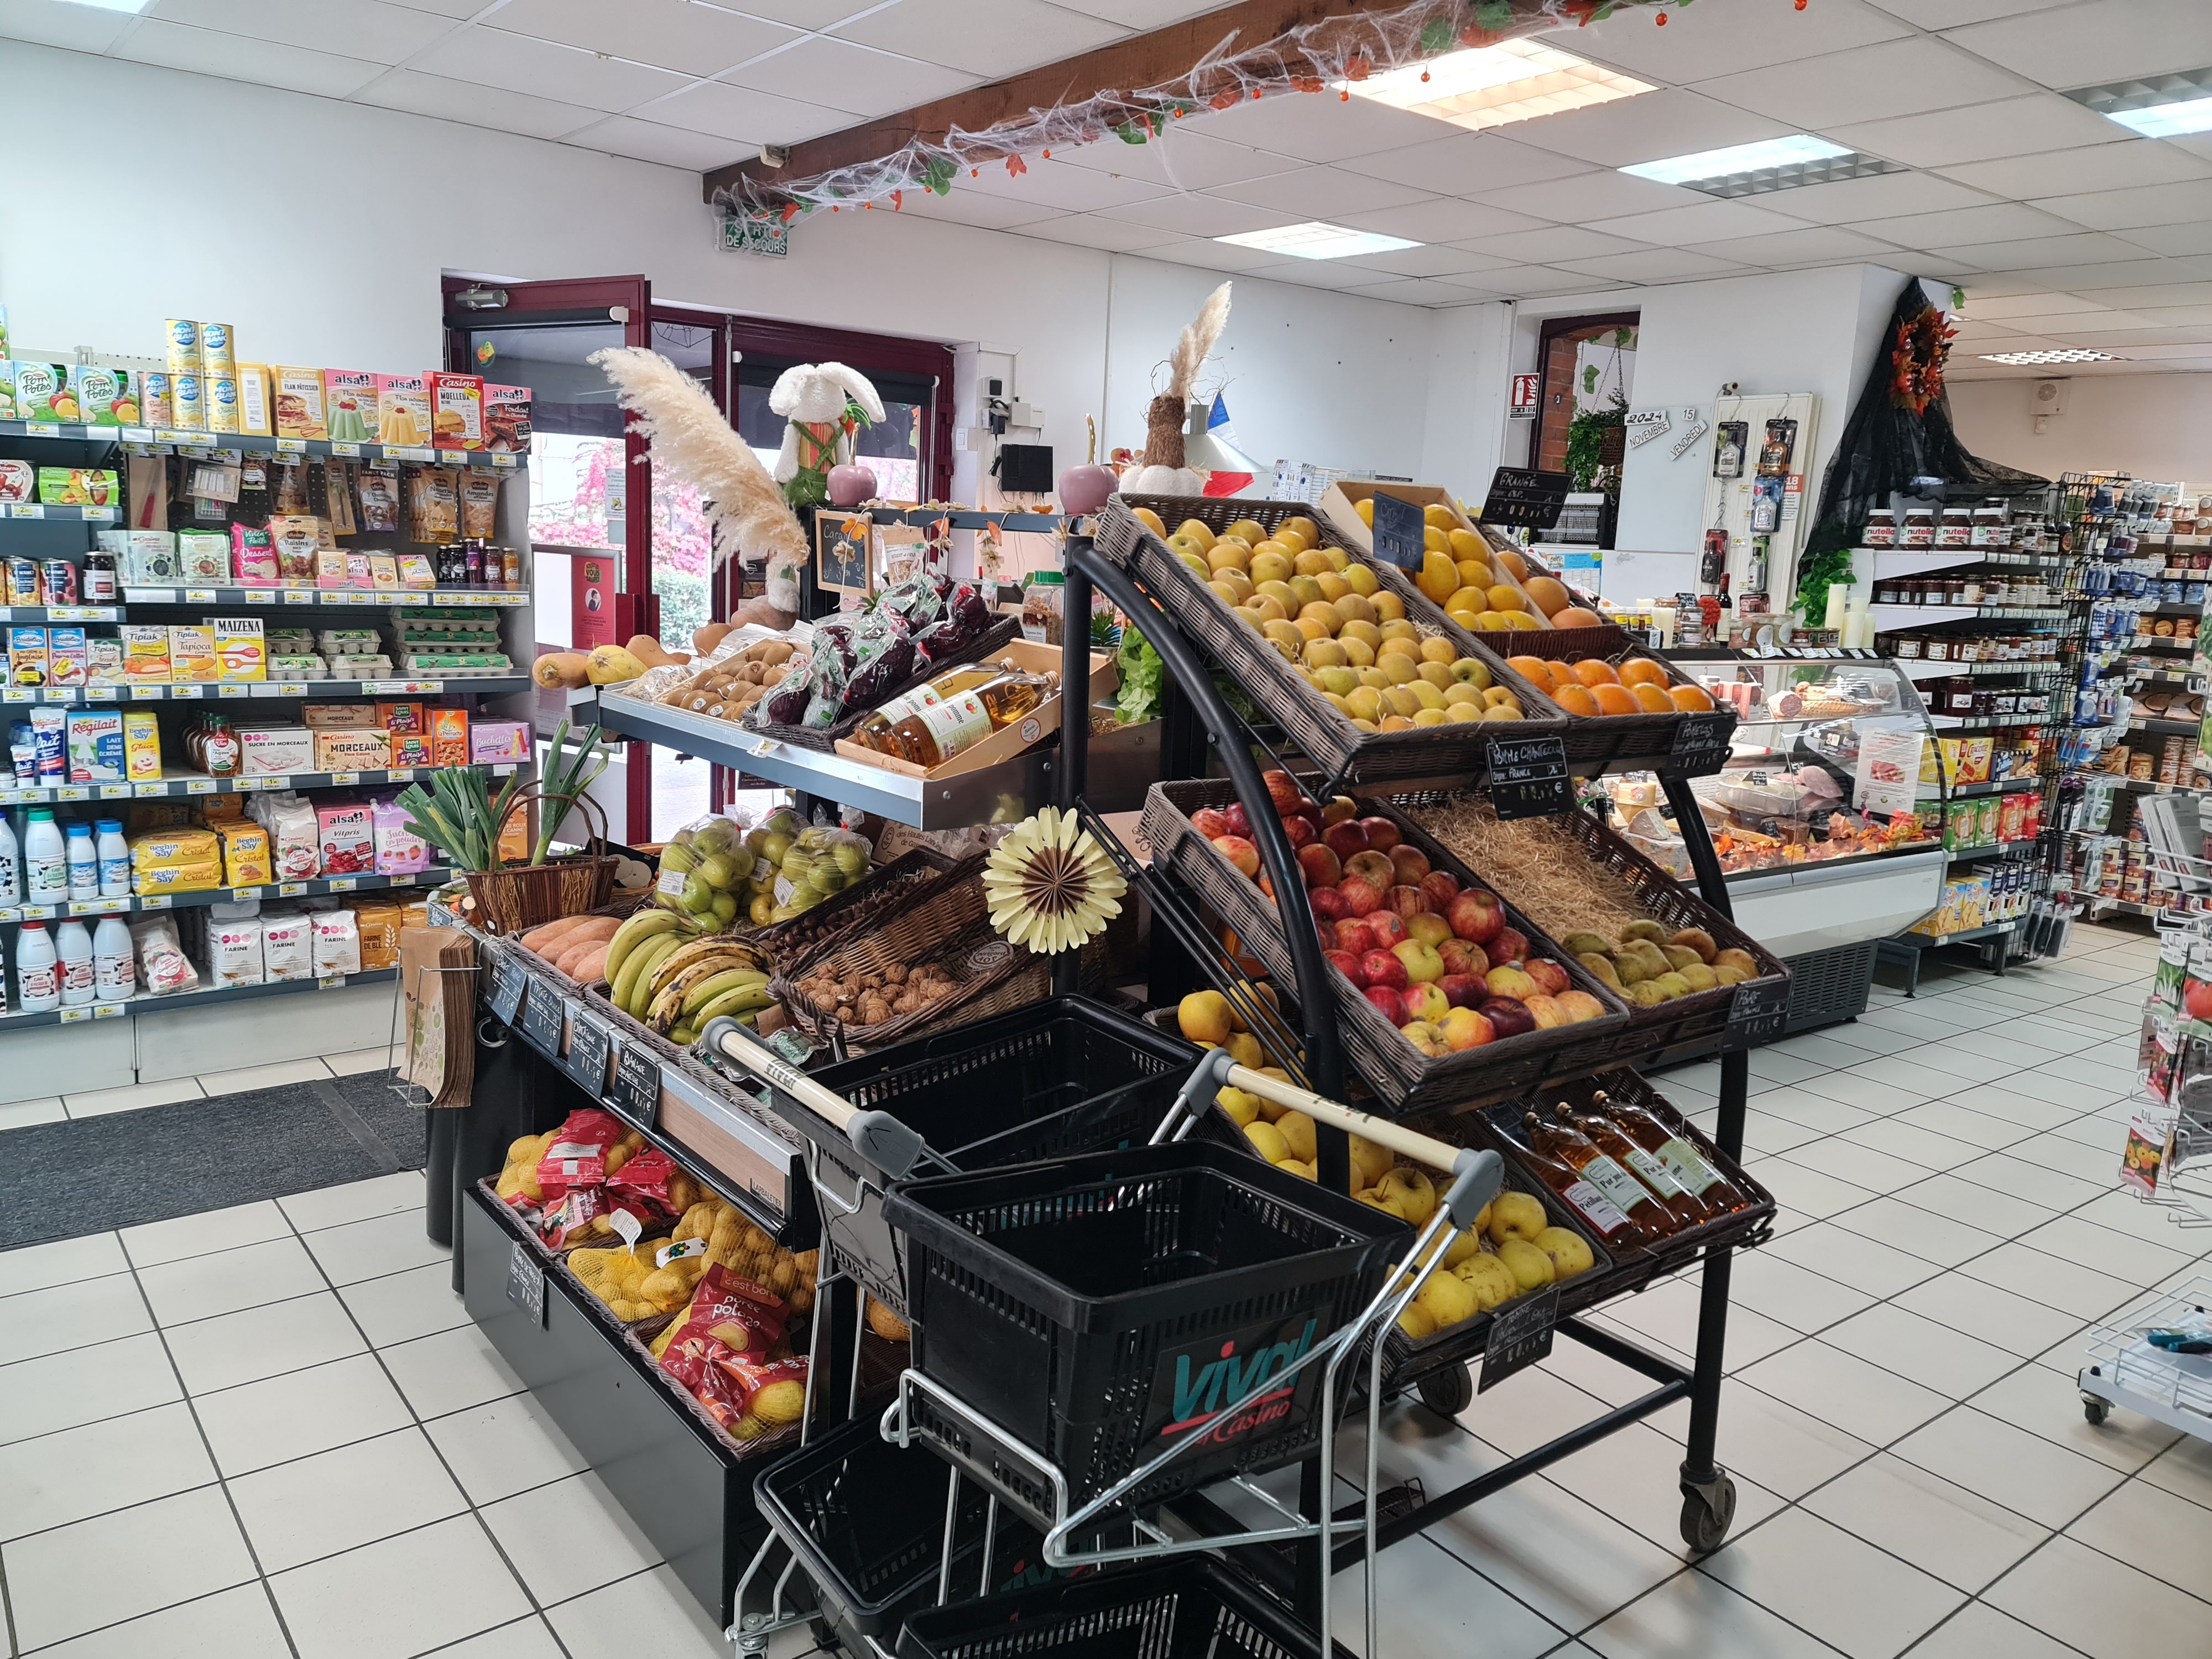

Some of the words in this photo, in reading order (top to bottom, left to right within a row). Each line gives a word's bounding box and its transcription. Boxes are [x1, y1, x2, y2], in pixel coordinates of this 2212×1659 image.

[727, 234, 740, 247] DE
[283, 369, 316, 379] Casino
[335, 374, 360, 385] alsa
[388, 379, 412, 390] alsa
[440, 378, 476, 387] Casino
[23, 383, 51, 394] Potes
[85, 389, 113, 399] Potes
[441, 392, 471, 401] MOELLEUX
[492, 389, 515, 399] alsa
[504, 404, 529, 414] Fondant
[1682, 409, 1694, 419] 15
[1626, 411, 1662, 424] 2024
[1629, 421, 1669, 447] NOVEMBRE
[1670, 424, 1704, 457] VENDREDI
[466, 489, 494, 498] Amandes
[1867, 528, 1895, 536] nutella
[1907, 528, 1934, 536] nutella
[1943, 528, 1971, 536] nutella
[240, 547, 274, 557] Dessert
[218, 620, 261, 632] MAIZENA
[129, 633, 159, 642] Tipiak
[178, 640, 211, 651] Tapioca
[15, 653, 44, 661] Anglaise
[947, 704, 964, 724] pomme
[72, 719, 118, 737] Régilait
[133, 732, 149, 740] Say
[36, 734, 61, 749] lait
[131, 743, 155, 752] Glace
[331, 743, 384, 752] MORCEAUX
[15, 762, 32, 771] lait
[330, 815, 354, 825] alsa
[333, 829, 361, 837] Vitpris
[241, 842, 257, 851] Say
[155, 850, 173, 858] Say
[181, 847, 211, 857] Cristal
[234, 854, 265, 863] Cristal
[156, 875, 175, 884] Say
[182, 872, 213, 883] Cristal
[624, 1050, 646, 1076] BANANE
[1599, 1178, 1614, 1190] Pur
[1611, 1173, 1621, 1183] jus
[753, 1181, 782, 1208] LARBALETIER
[752, 1283, 774, 1298] bon
[712, 1303, 761, 1328] potage
[1172, 1318, 1317, 1422] Vival
[1212, 1400, 1291, 1442] Casino
